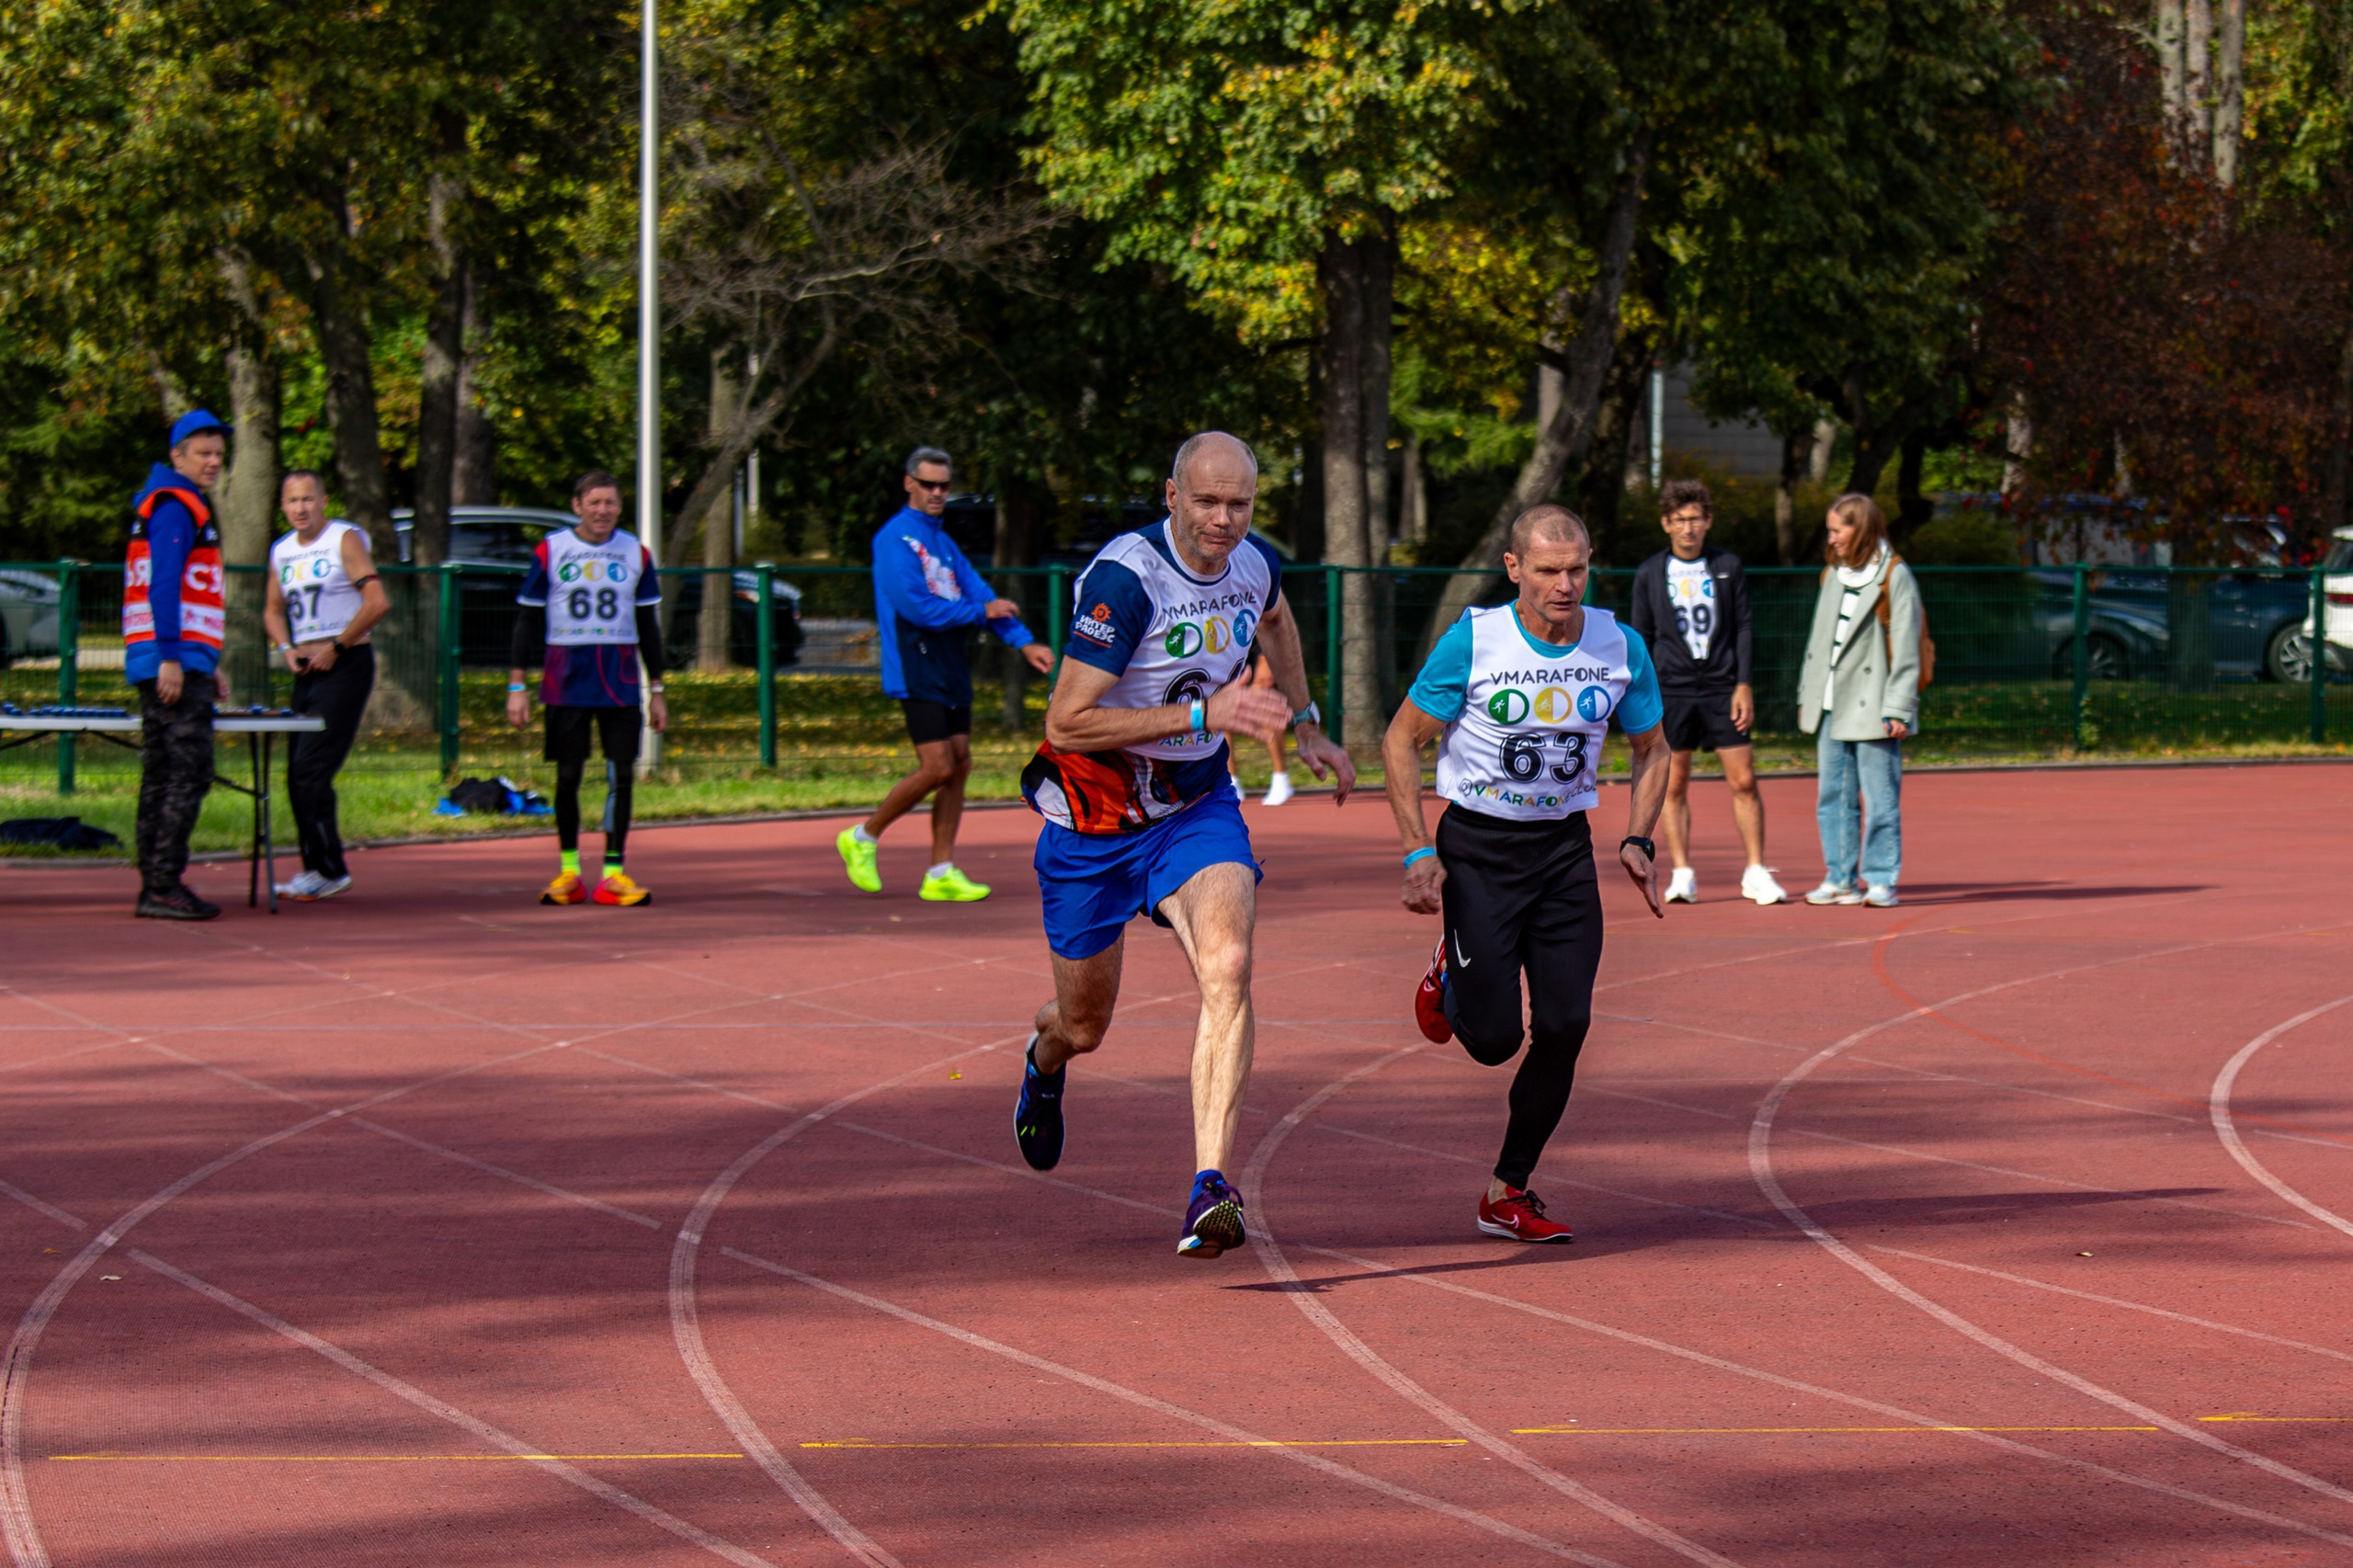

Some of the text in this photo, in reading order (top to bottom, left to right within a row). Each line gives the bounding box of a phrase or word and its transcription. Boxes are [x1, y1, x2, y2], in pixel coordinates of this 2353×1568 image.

[286, 584, 324, 620] 67
[569, 587, 618, 621] 68
[1162, 591, 1256, 619] VMARAFONE
[1674, 603, 1711, 635] 69
[1491, 667, 1611, 686] VMARAFONE
[1499, 732, 1590, 784] 63
